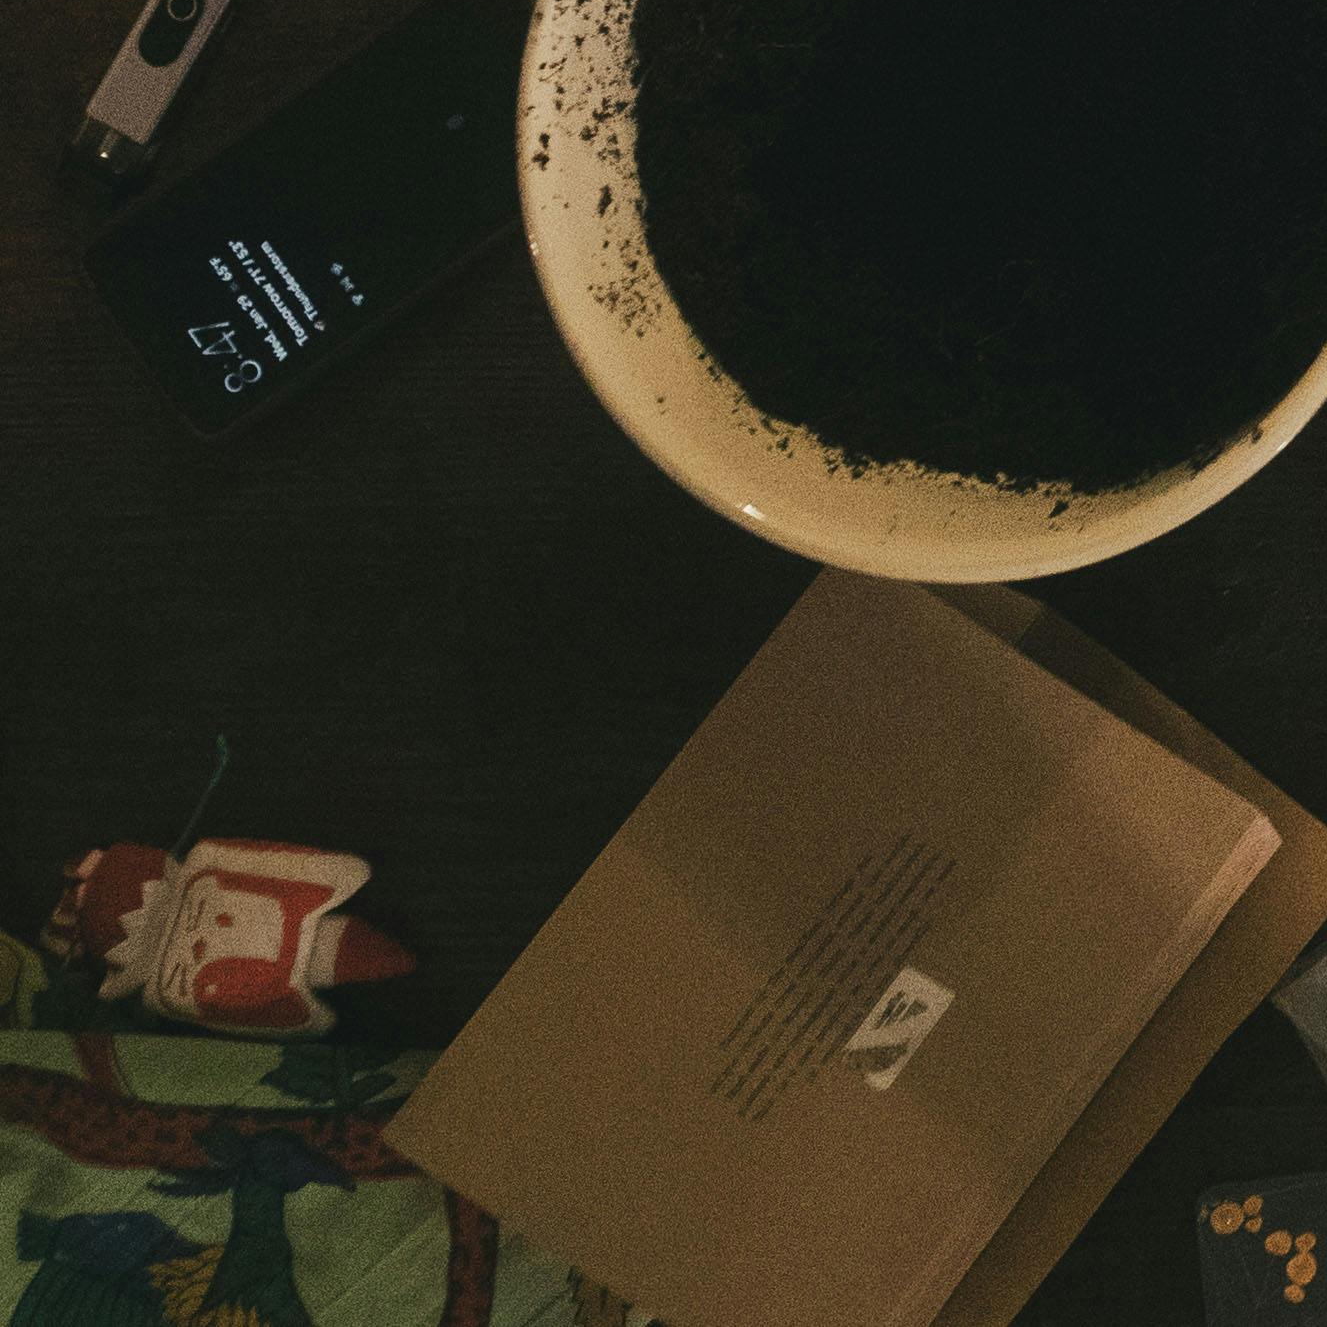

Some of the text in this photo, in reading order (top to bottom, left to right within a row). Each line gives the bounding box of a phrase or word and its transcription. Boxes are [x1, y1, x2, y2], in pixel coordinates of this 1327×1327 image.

[235, 291, 253, 311] 29
[258, 237, 320, 322] Thunderstorm
[259, 278, 311, 348] Tomorrow
[185, 306, 267, 398] 8:47
[246, 306, 269, 333] Jan
